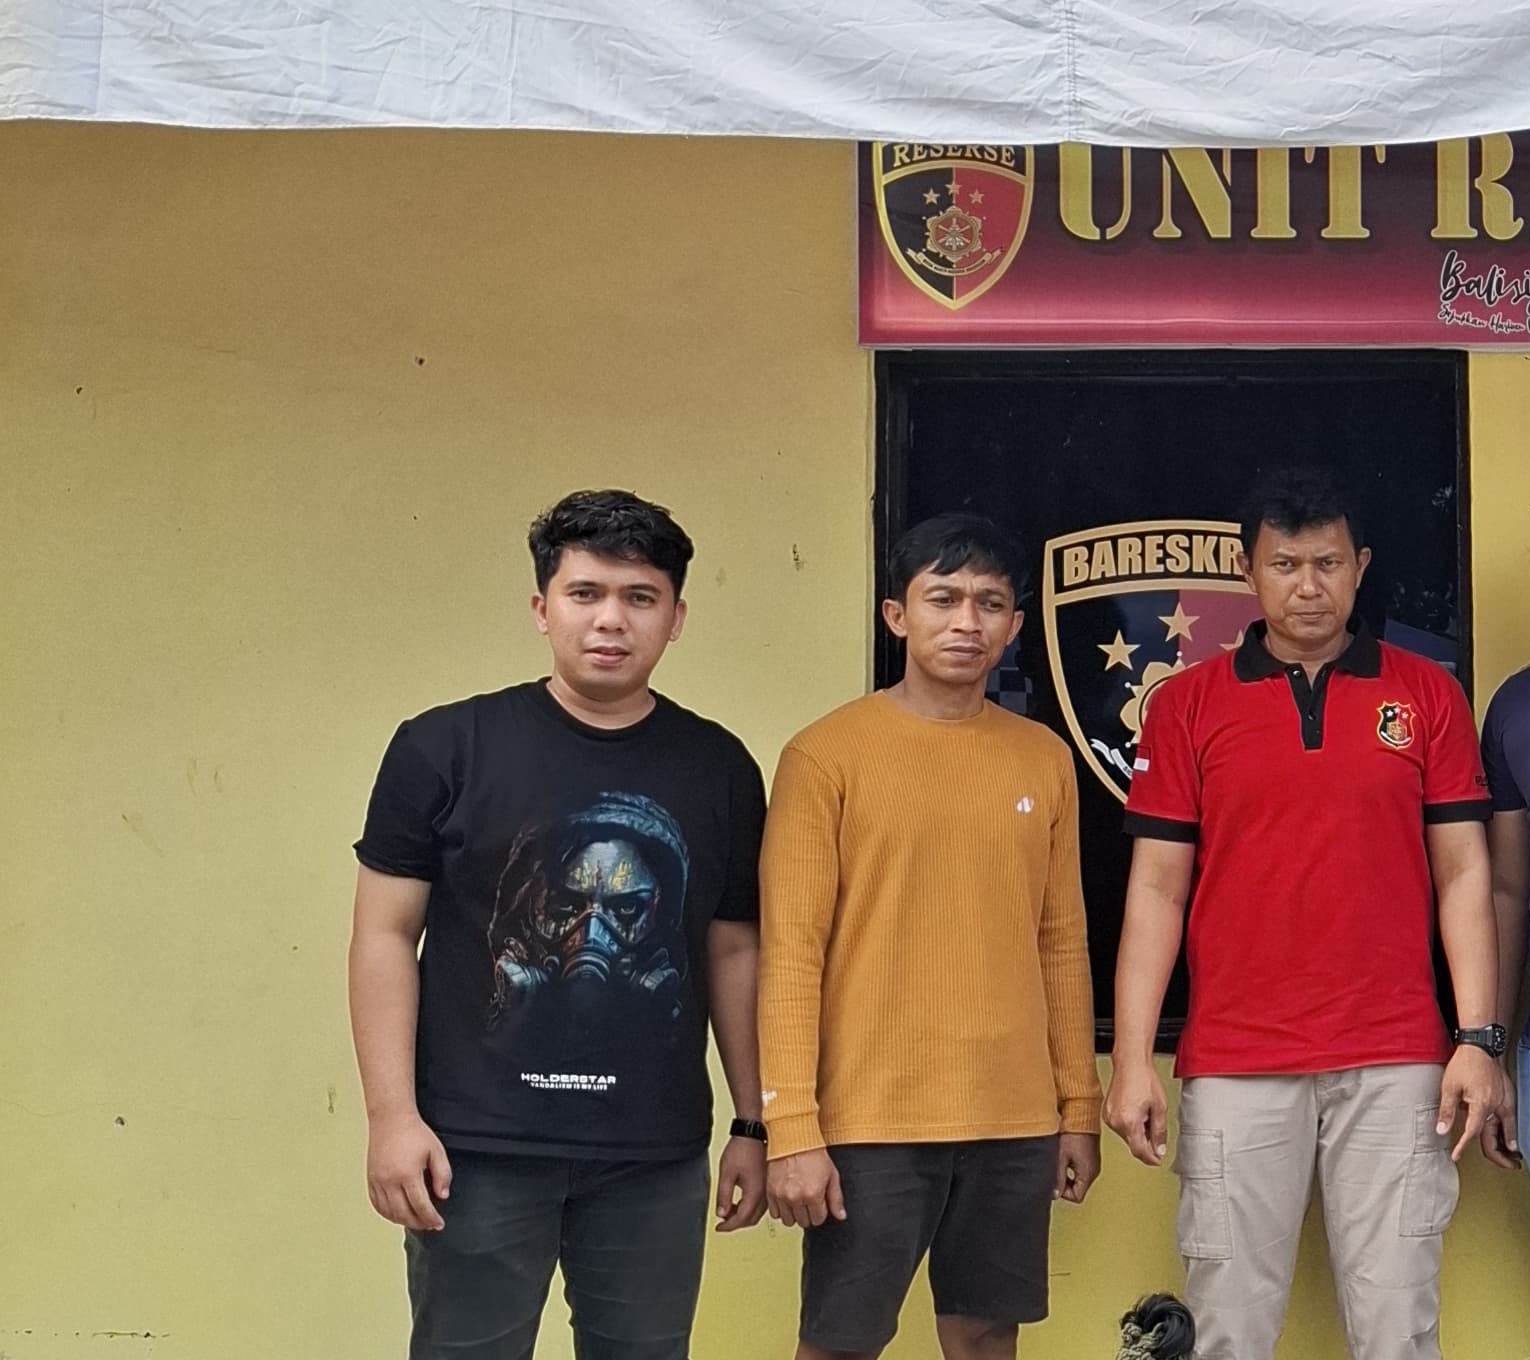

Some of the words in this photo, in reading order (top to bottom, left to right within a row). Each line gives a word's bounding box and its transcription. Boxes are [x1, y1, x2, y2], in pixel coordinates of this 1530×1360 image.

[893, 143, 1016, 168] RESERSE
[1057, 140, 1387, 241] UNIT
[1063, 534, 1244, 587] BARESKR
[520, 1072, 617, 1085] HOLDERSTAR
